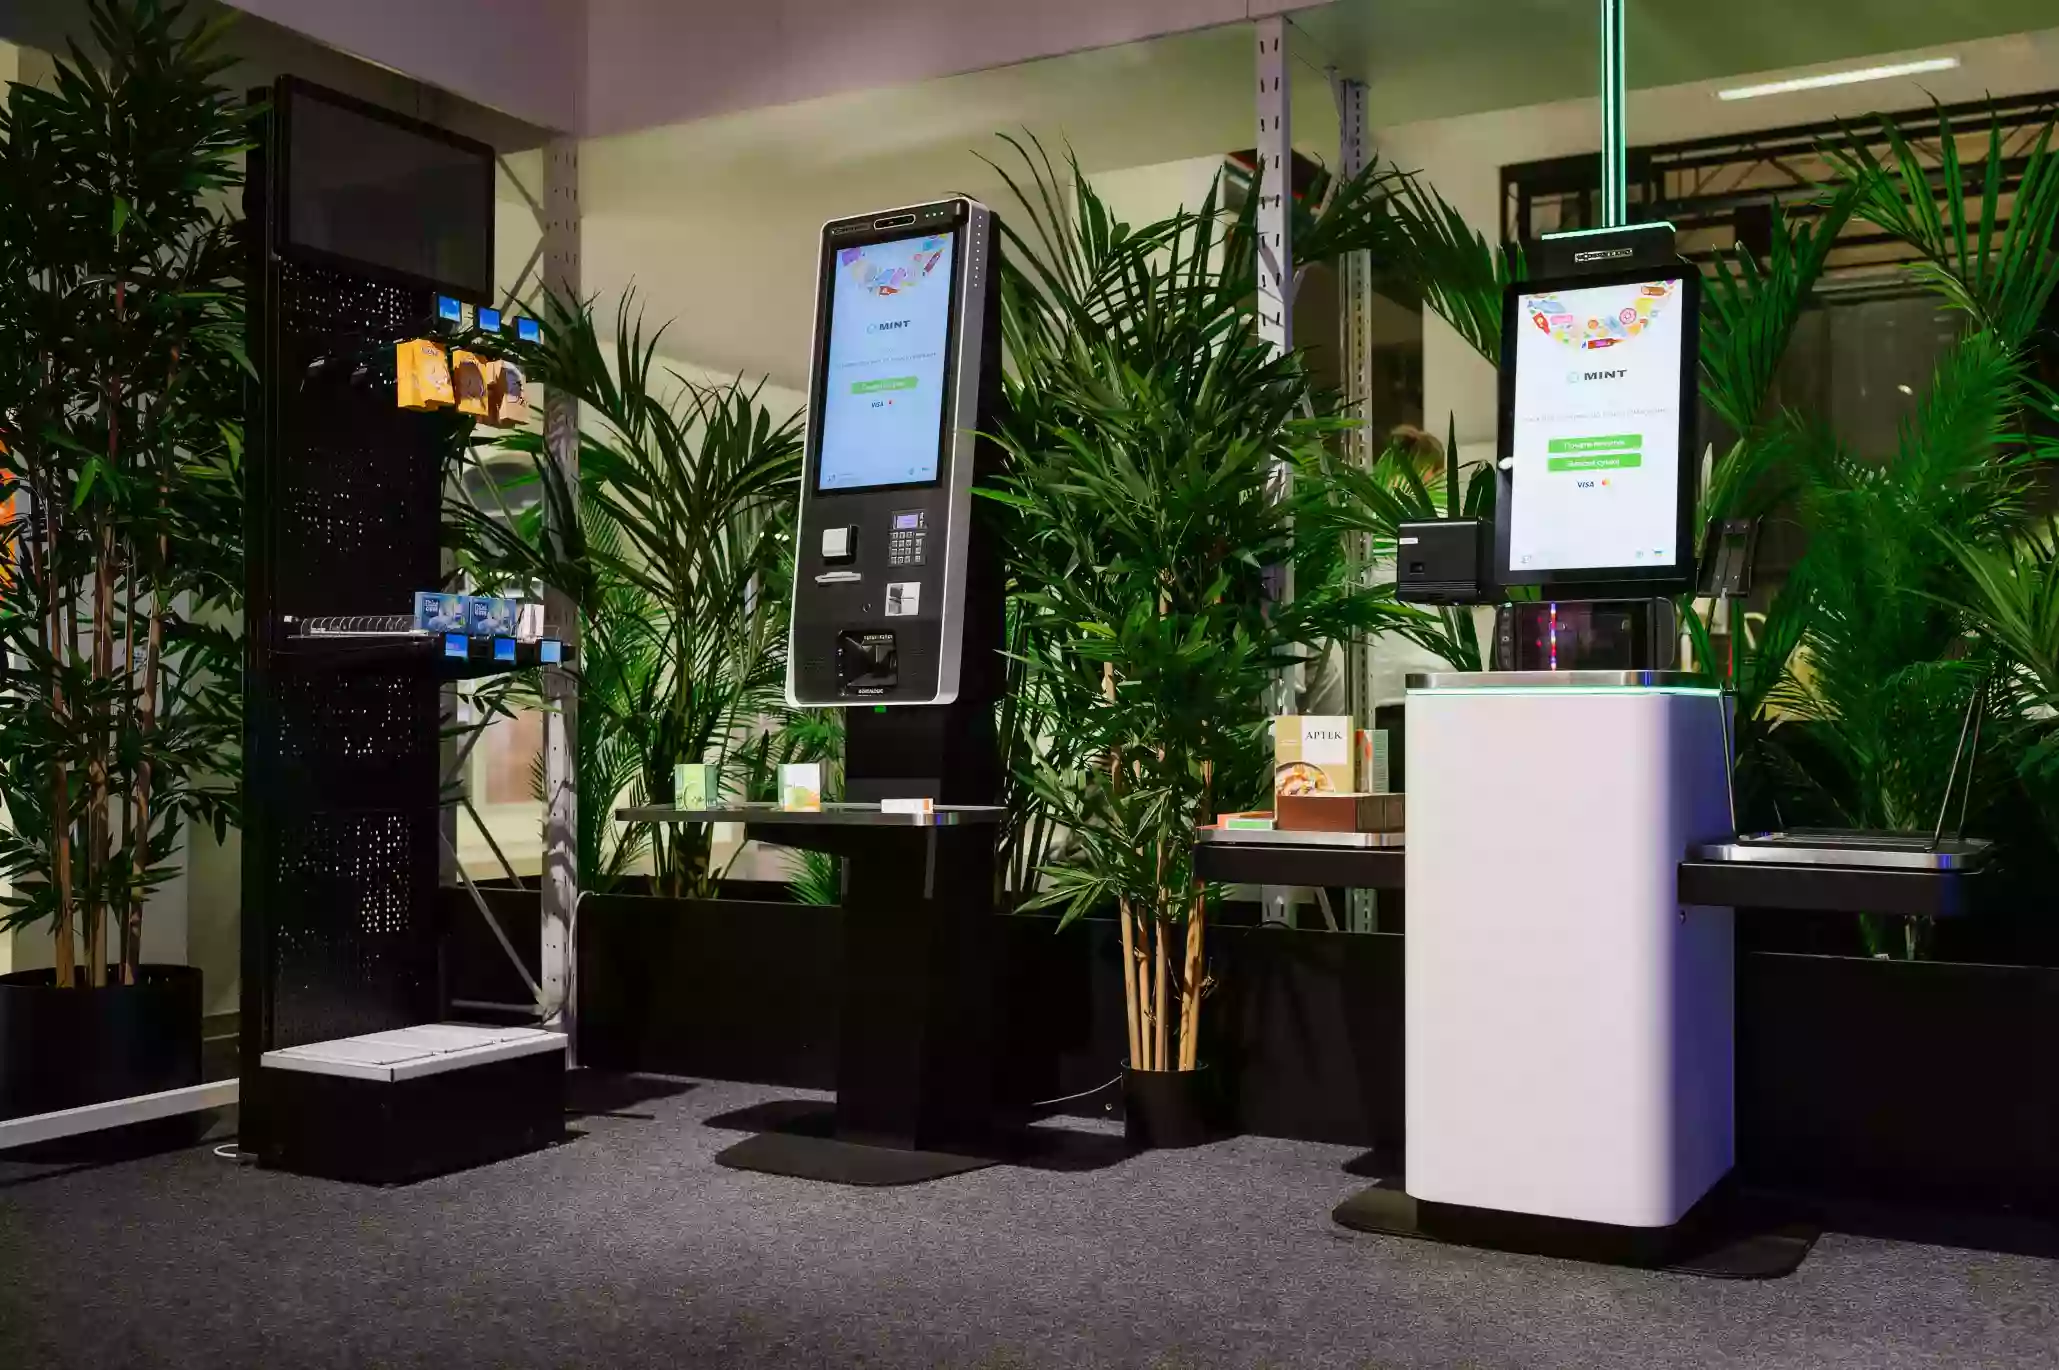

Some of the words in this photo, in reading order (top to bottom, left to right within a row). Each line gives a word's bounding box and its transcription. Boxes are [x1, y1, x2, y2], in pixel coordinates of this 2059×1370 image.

[879, 320, 911, 331] MINT
[1584, 370, 1627, 381] MINT
[1305, 731, 1342, 740] APTEK
